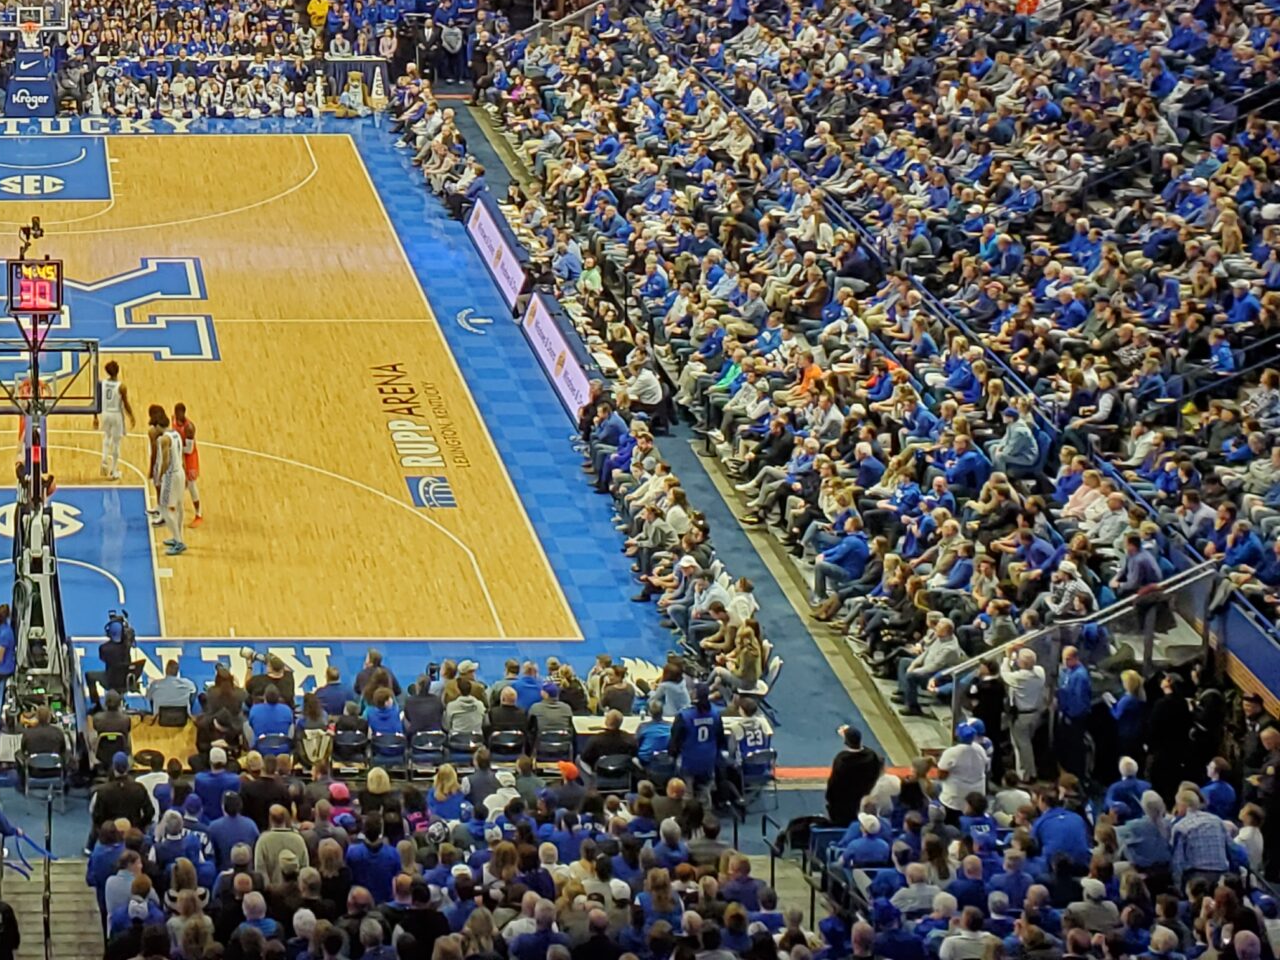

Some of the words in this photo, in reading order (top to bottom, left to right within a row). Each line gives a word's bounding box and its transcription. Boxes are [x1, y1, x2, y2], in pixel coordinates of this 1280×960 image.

[12, 88, 50, 110] Kroger
[22, 264, 56, 281] 4:45
[20, 280, 51, 308] 30
[368, 362, 426, 418] ARENA
[388, 418, 448, 468] RUPP
[698, 726, 709, 743] 0
[746, 730, 762, 746] 23
